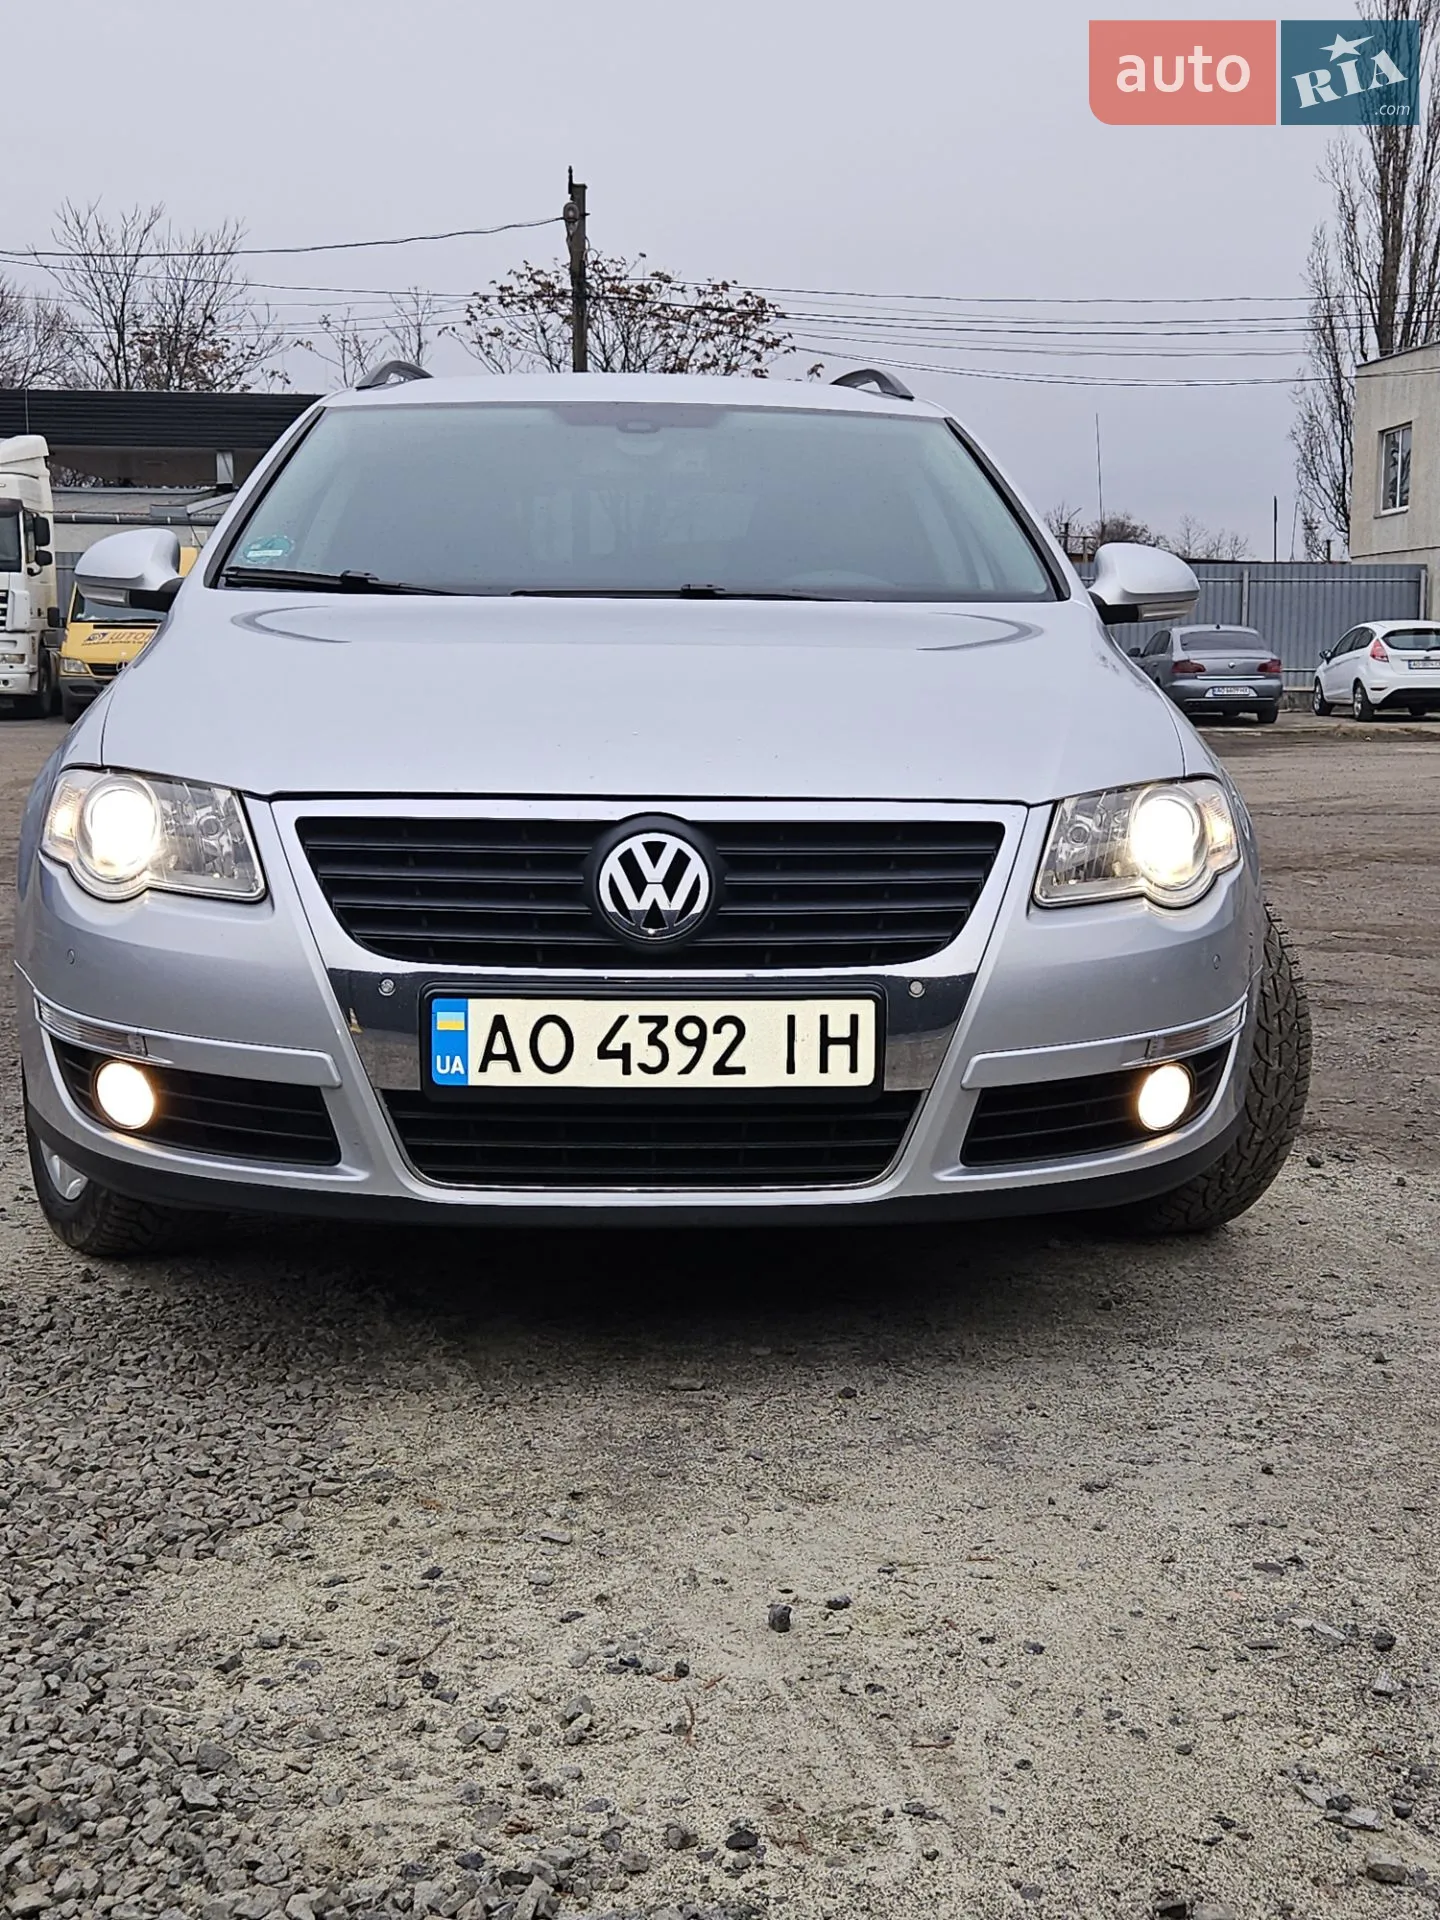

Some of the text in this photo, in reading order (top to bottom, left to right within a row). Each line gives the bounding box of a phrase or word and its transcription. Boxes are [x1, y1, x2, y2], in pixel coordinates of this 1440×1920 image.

[436, 1056, 465, 1075] UA
[478, 1013, 860, 1077] AO 4392 IH
